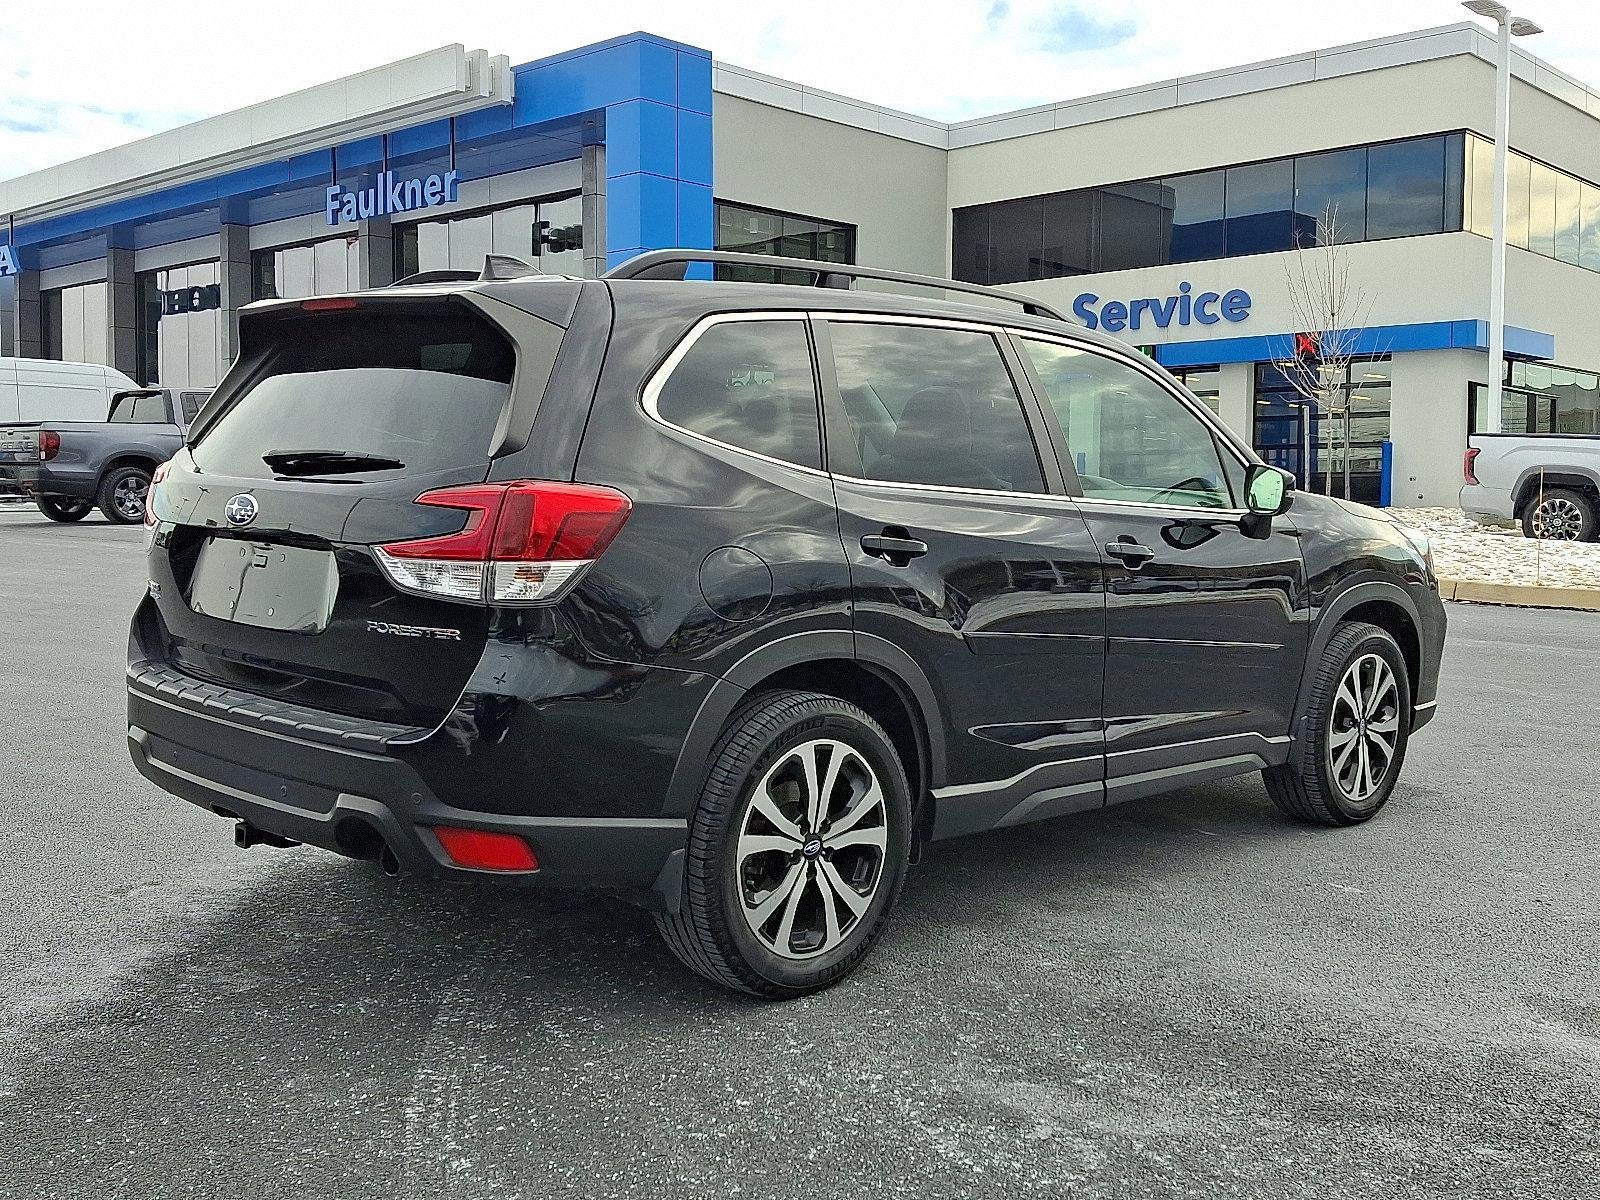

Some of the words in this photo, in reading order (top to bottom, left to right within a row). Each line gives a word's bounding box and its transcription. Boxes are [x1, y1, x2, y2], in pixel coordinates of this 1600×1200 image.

[326, 170, 459, 225] Faulkner
[1072, 281, 1252, 332] Service
[366, 620, 462, 641] FORESTER
